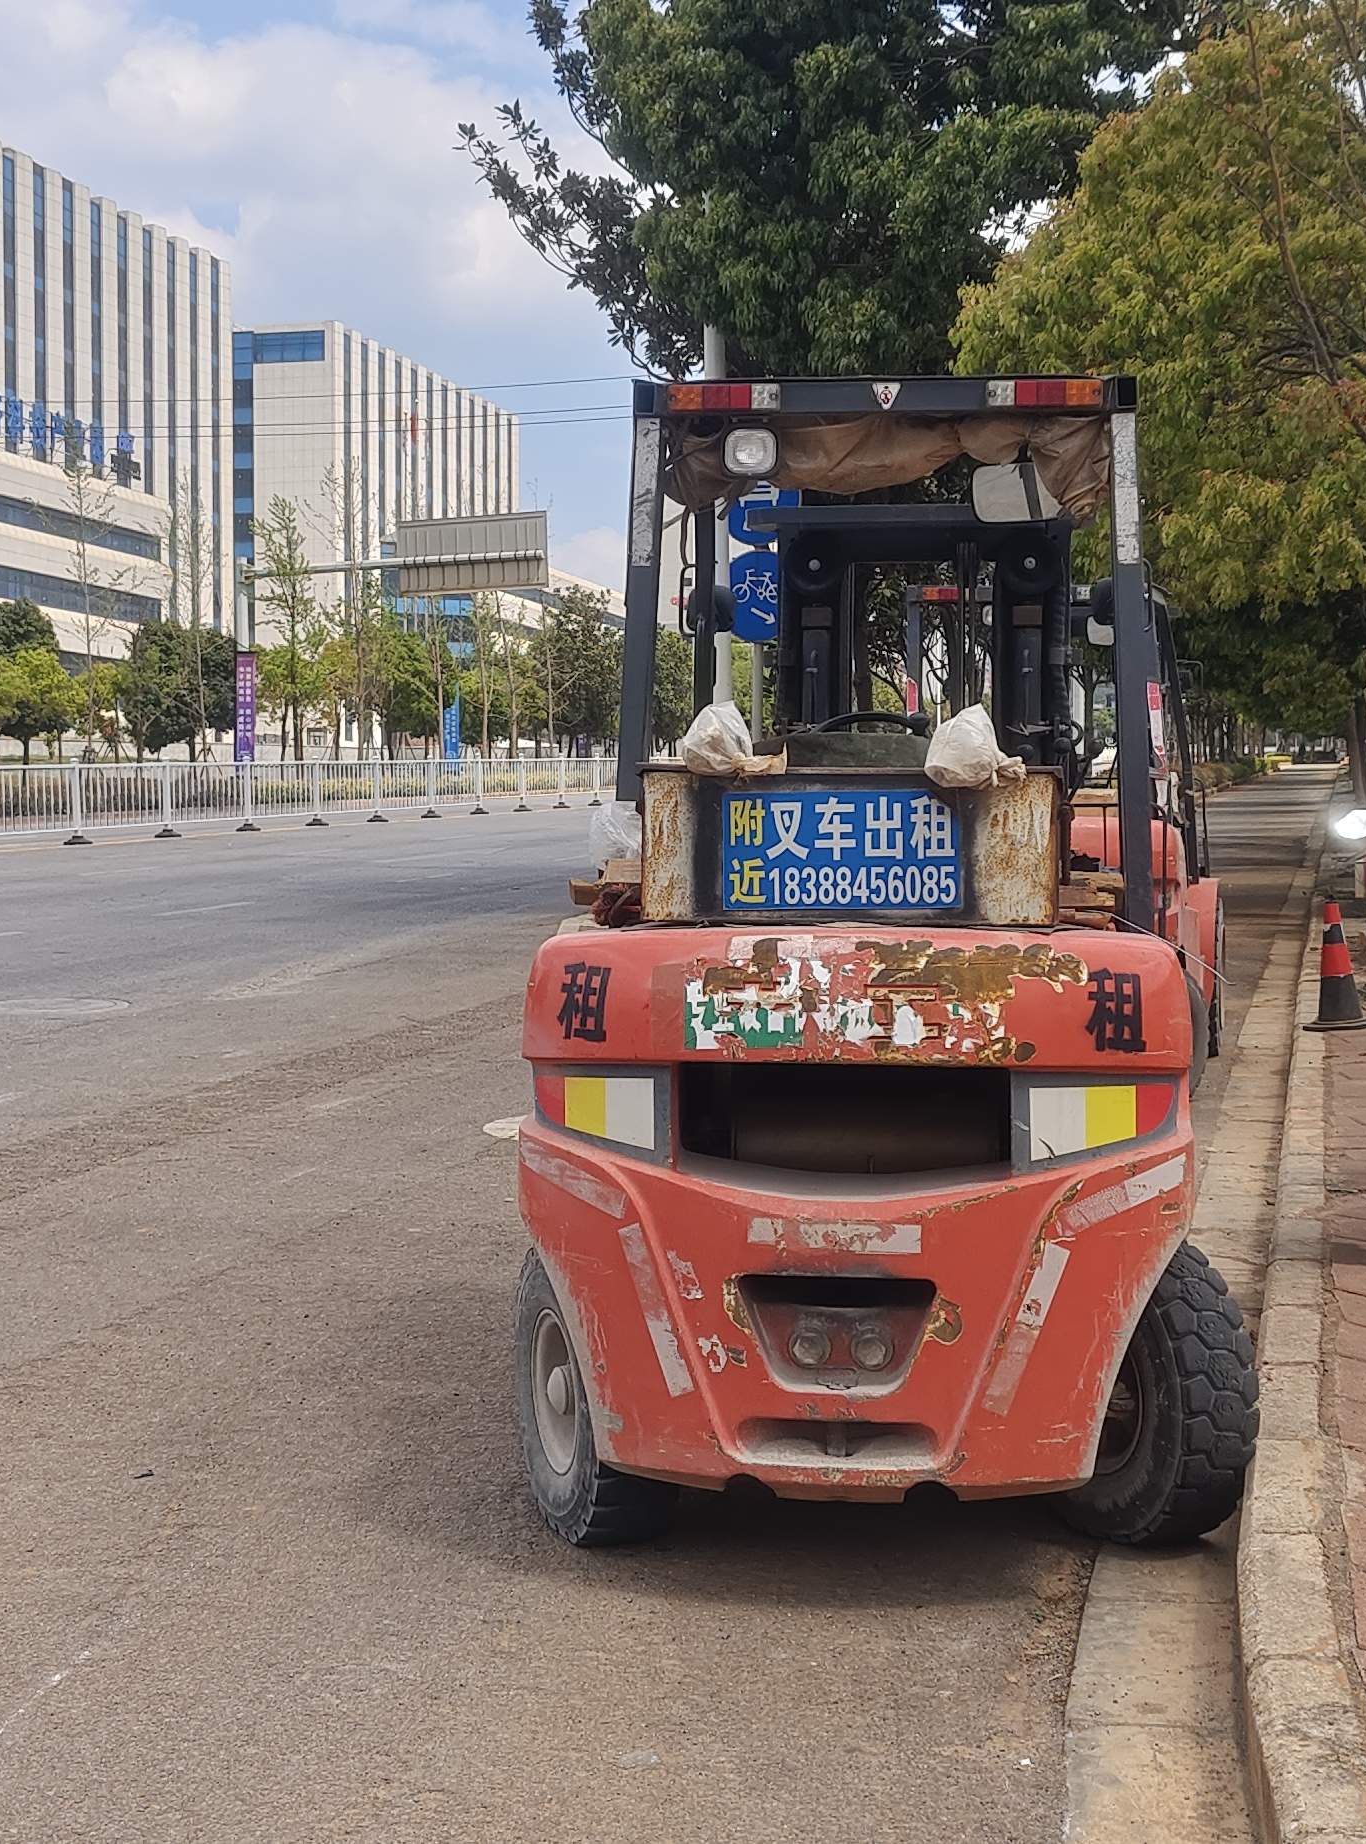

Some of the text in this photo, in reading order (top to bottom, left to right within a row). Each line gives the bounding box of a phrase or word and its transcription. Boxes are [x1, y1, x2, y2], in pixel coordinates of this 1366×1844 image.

[766, 795, 956, 861] 叉车出租
[769, 865, 957, 905] 18388456085
[556, 961, 612, 1042] 租
[1085, 967, 1147, 1053] 租
